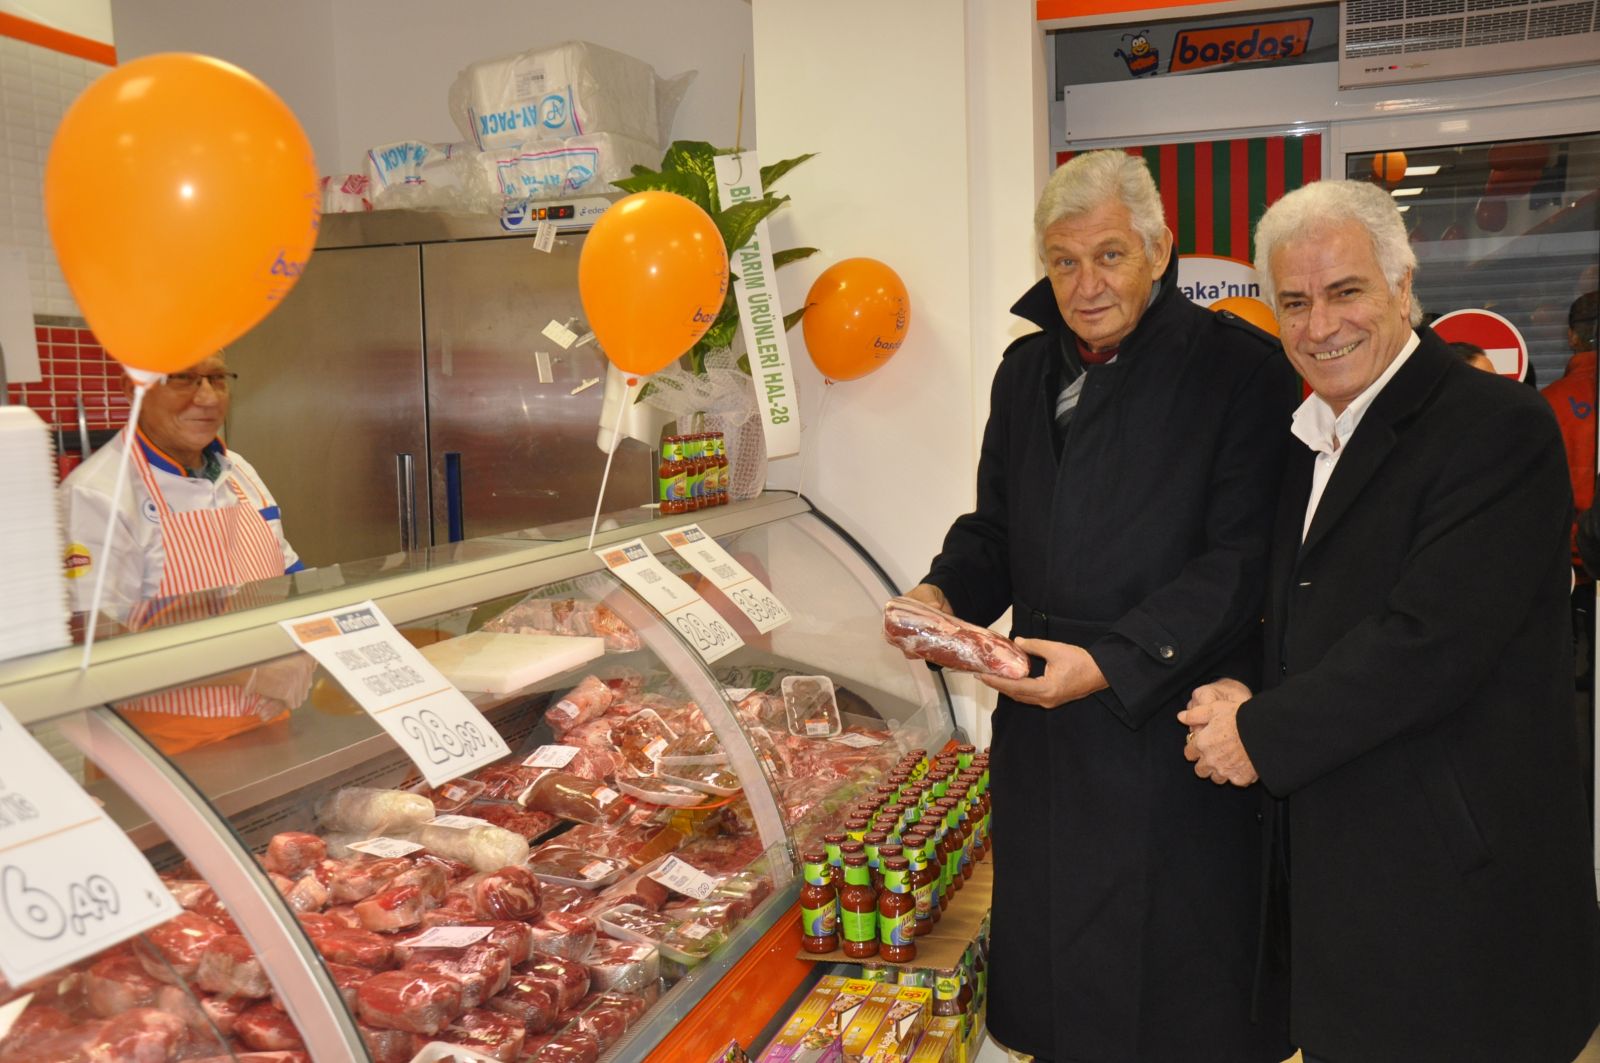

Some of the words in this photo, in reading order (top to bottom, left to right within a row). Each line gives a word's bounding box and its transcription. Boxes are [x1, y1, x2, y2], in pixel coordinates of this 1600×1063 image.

[1179, 29, 1294, 64] başdaş
[480, 105, 537, 135] AY-PACK
[739, 241, 766, 290] TARIM
[1179, 281, 1260, 300] aka’nın
[748, 292, 786, 369] ÜRÜNLERİ
[763, 372, 790, 425] HAL-28
[676, 612, 731, 651] 28,99
[401, 709, 487, 765] 28,99
[2, 864, 120, 941] 6,49
